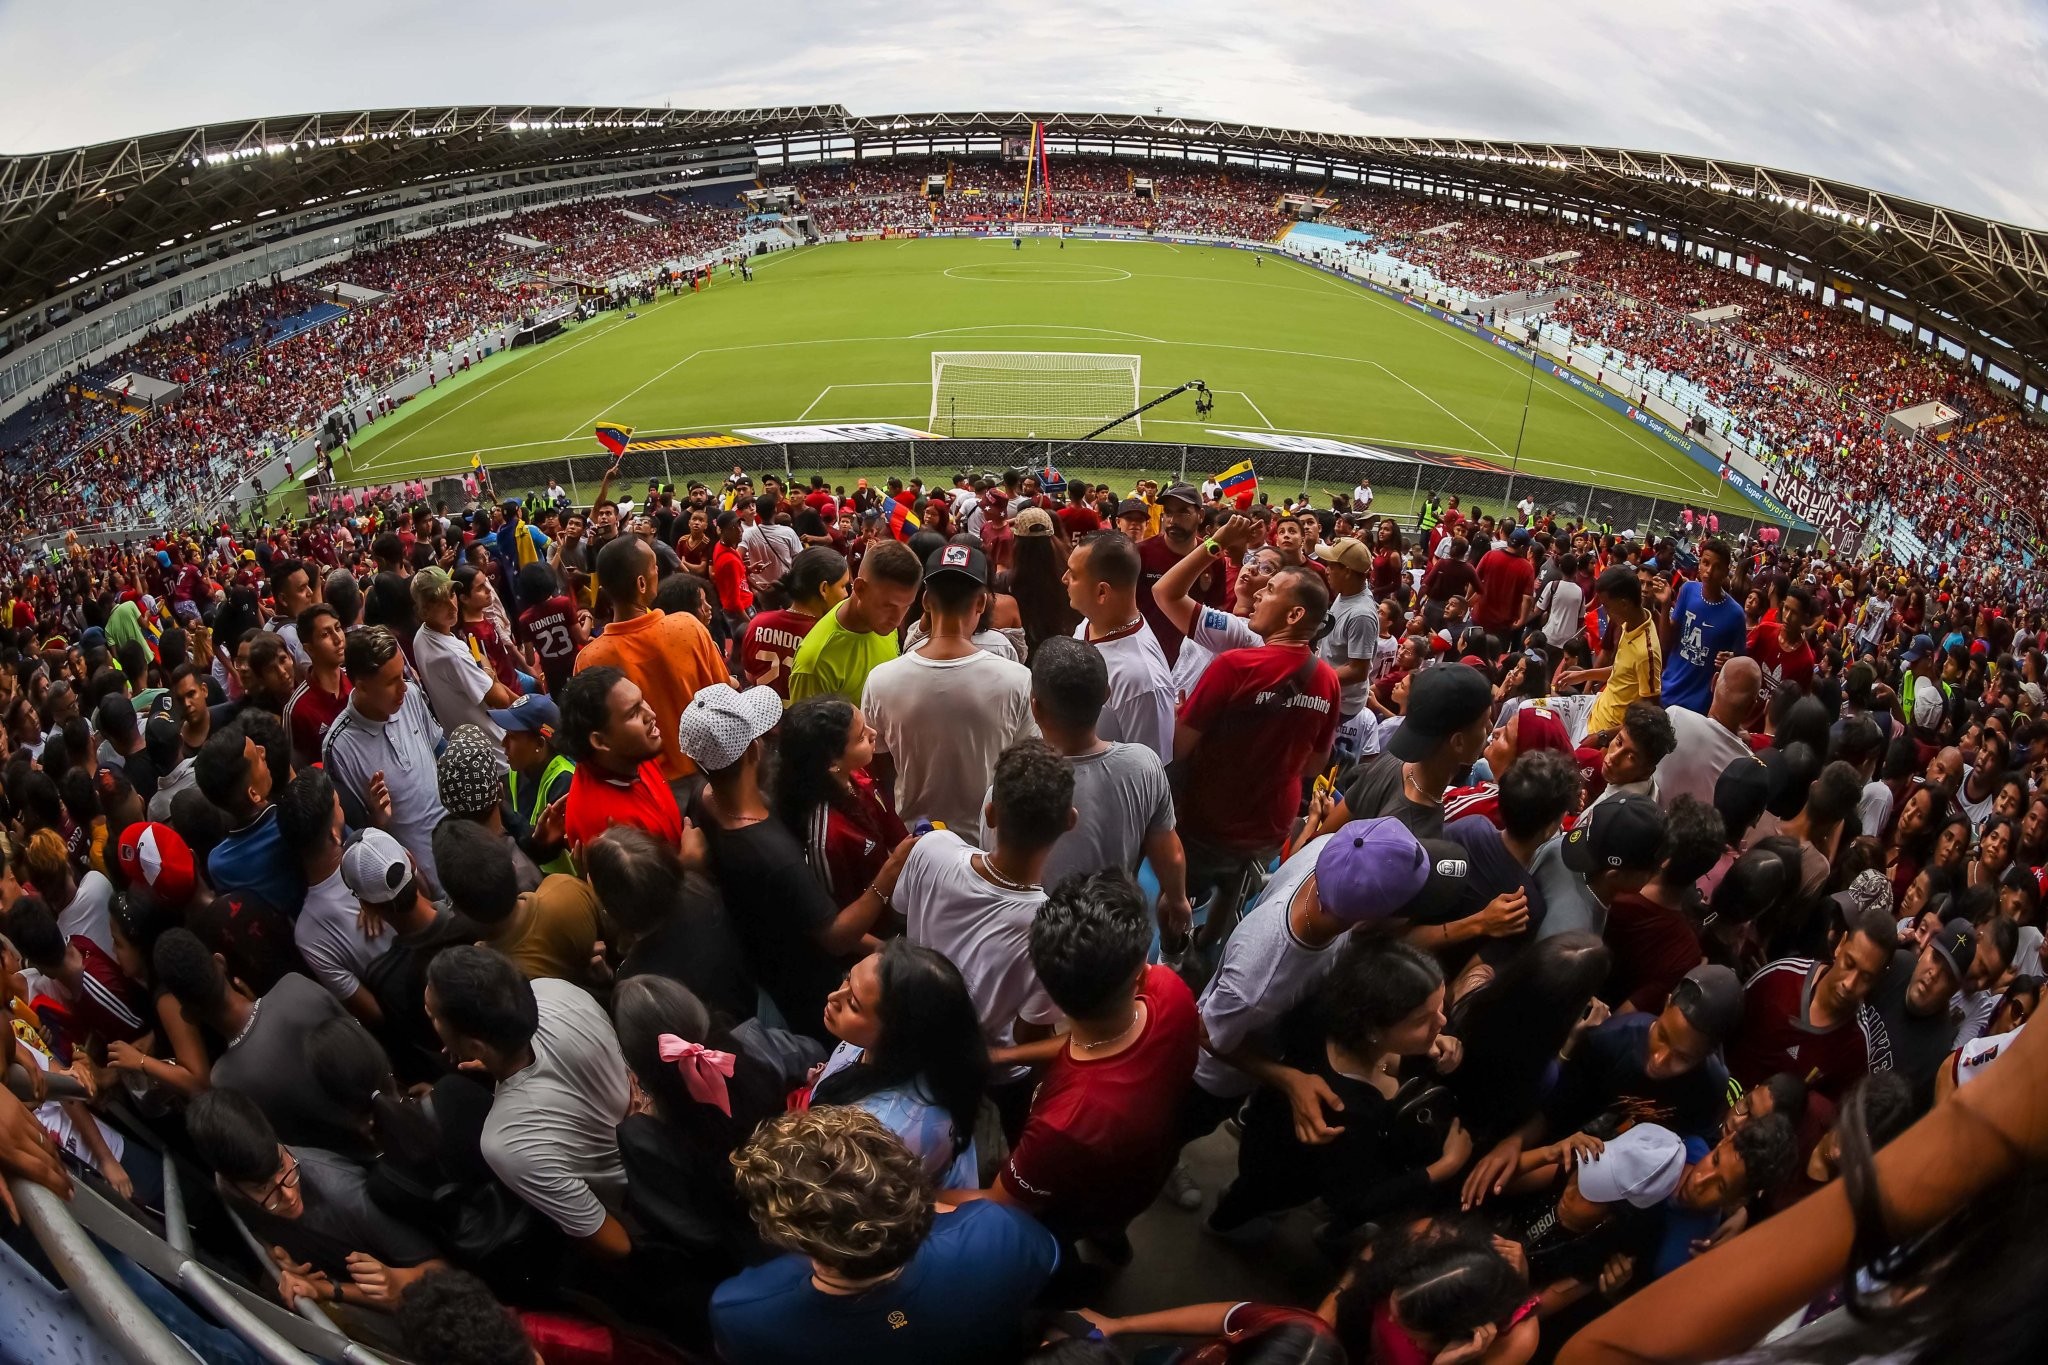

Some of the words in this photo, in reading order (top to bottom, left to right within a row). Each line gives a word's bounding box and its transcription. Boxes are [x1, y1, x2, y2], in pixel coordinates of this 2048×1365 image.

[1570, 374, 1583, 387] Super
[1582, 381, 1605, 399] Mayorista
[1648, 419, 1664, 433] Super
[1663, 429, 1692, 452] Mayorista
[1744, 483, 1763, 501] Super
[1762, 496, 1796, 527] Mayorista
[529, 612, 566, 632] RONDON
[755, 626, 804, 651] RONDO
[535, 625, 573, 658] 23
[755, 649, 794, 686] 2
